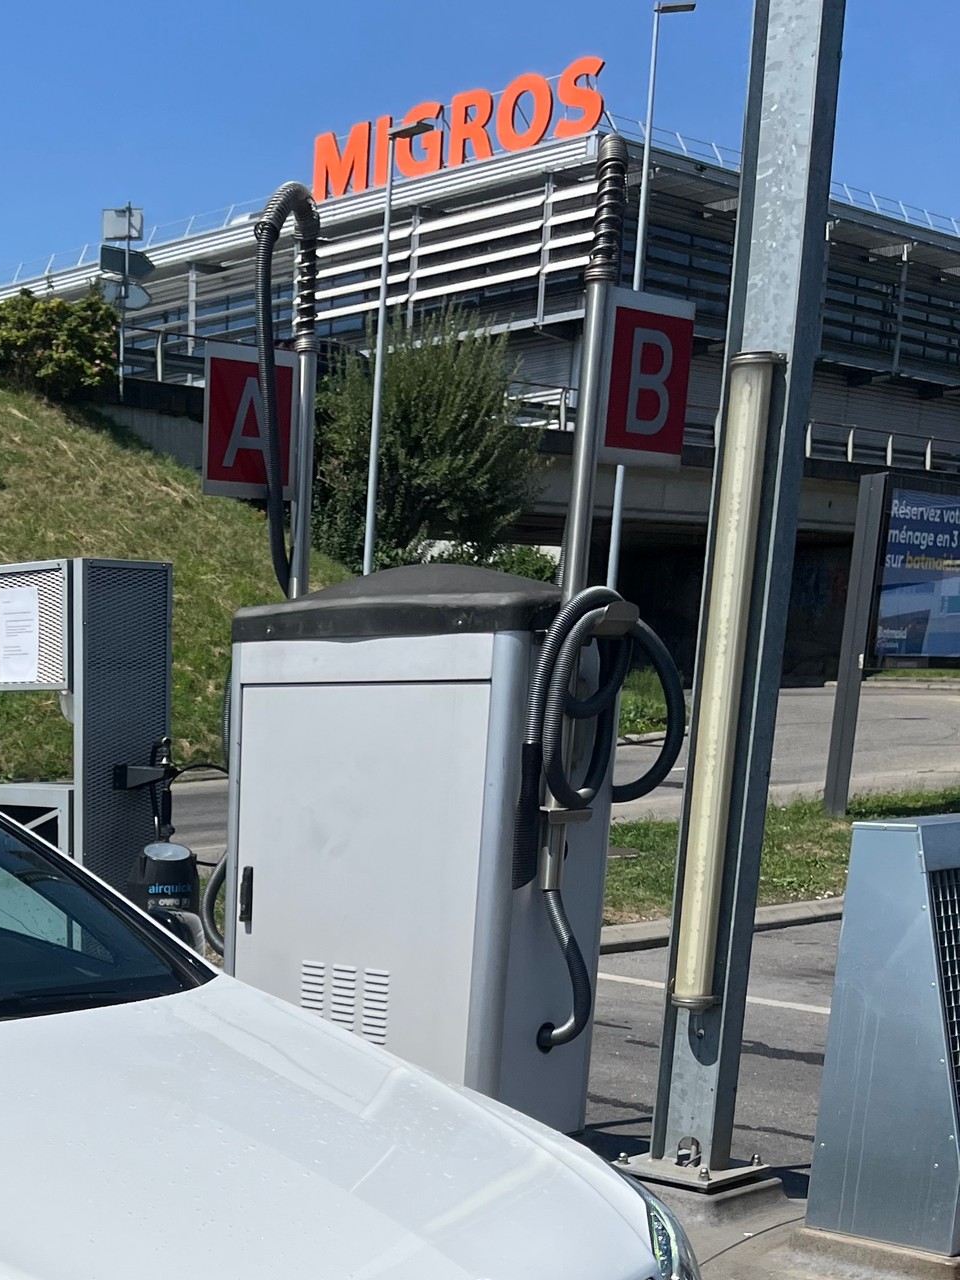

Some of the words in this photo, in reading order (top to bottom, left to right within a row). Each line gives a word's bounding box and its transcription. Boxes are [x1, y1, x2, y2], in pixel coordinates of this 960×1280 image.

[312, 56, 606, 203] MIGROS
[625, 326, 673, 436] B
[222, 376, 268, 468] A
[891, 499, 941, 523] Réservez
[888, 525, 934, 550] ménage
[936, 533, 950, 547] en
[951, 530, 959, 548] 3
[885, 554, 904, 568] sur
[148, 883, 192, 895] airquick
